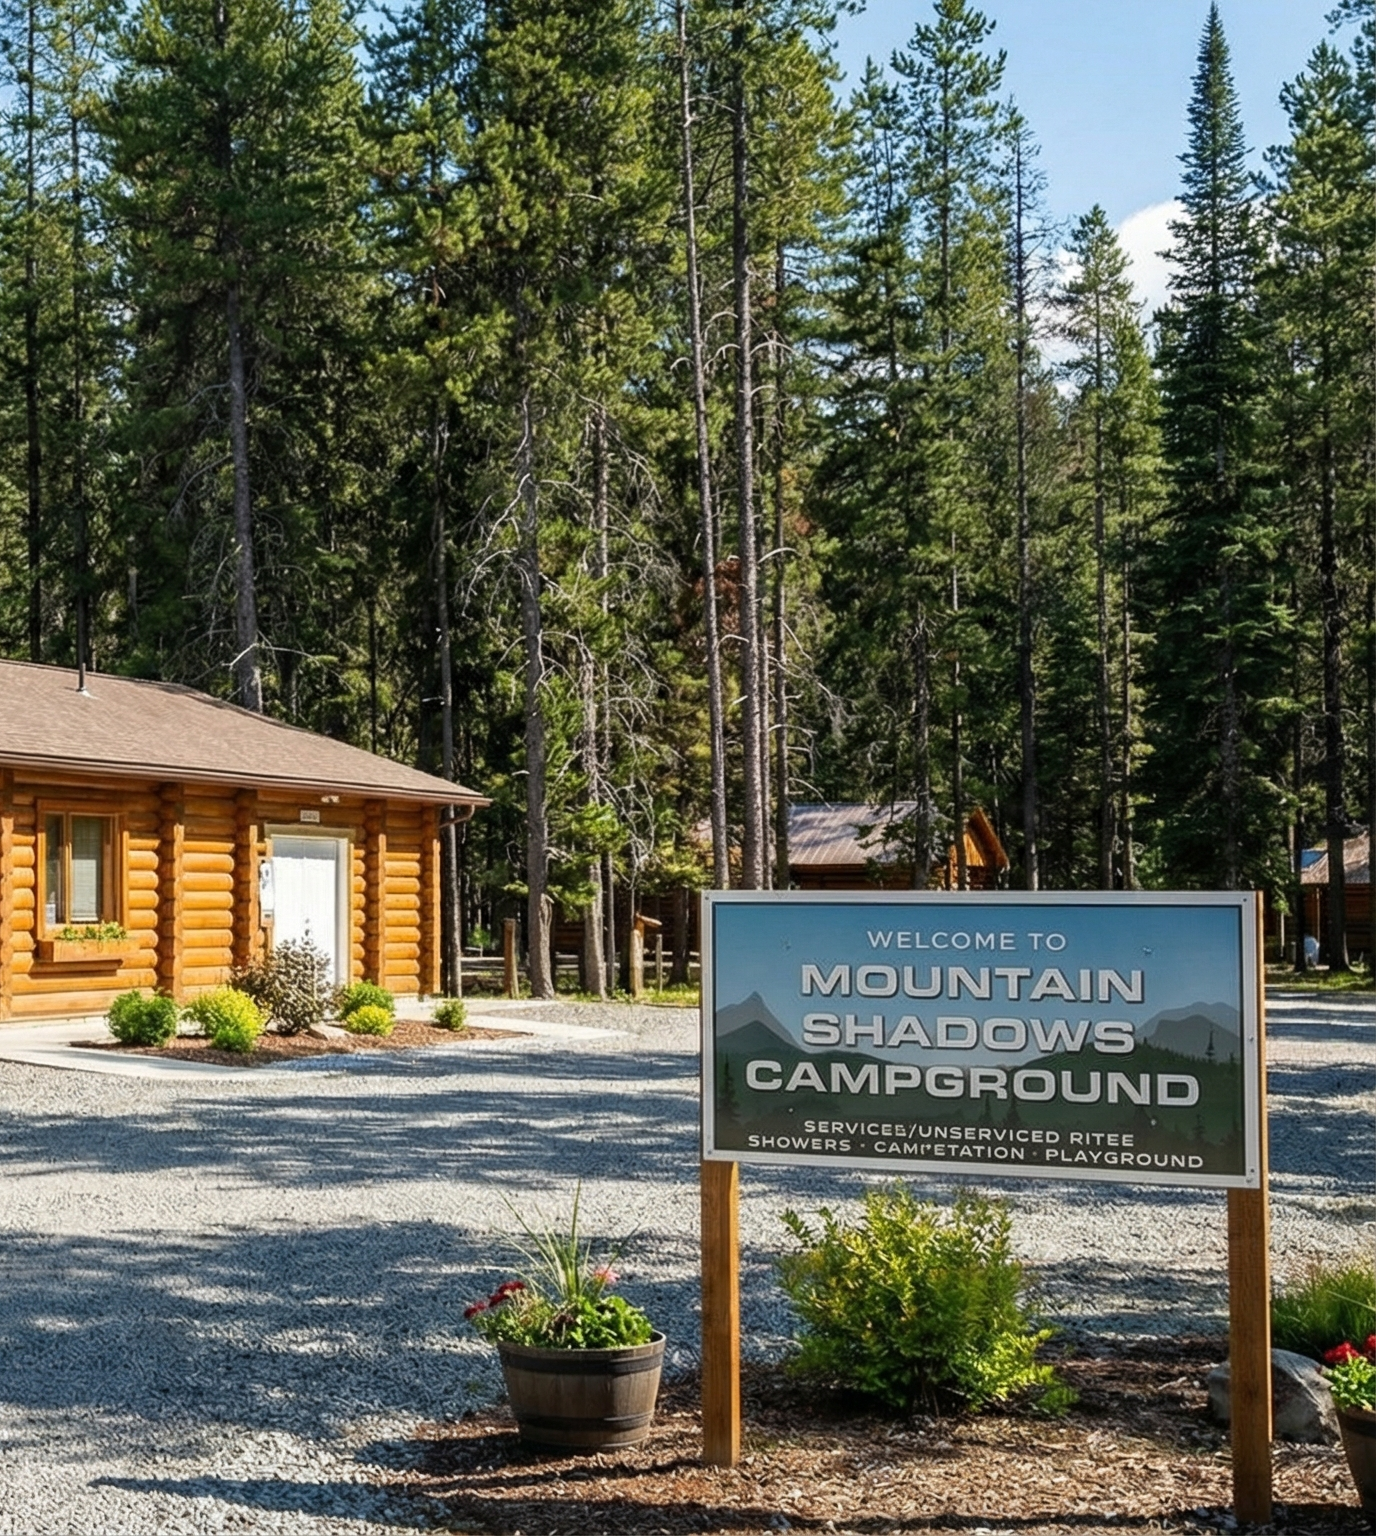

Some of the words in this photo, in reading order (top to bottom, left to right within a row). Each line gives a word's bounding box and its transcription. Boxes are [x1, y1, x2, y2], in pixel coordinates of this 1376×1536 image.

[867, 931, 1015, 951] WELCOME
[1028, 933, 1066, 951] TO
[801, 964, 1143, 1002] MOUNTAIN
[803, 1013, 1135, 1053] SHADOWS
[745, 1060, 1200, 1106] CAMPGROUND
[748, 1135, 851, 1151] SHOWERS
[1045, 1149, 1204, 1168] PLAYGROUND
[1070, 1132, 1134, 1147] RITEE
